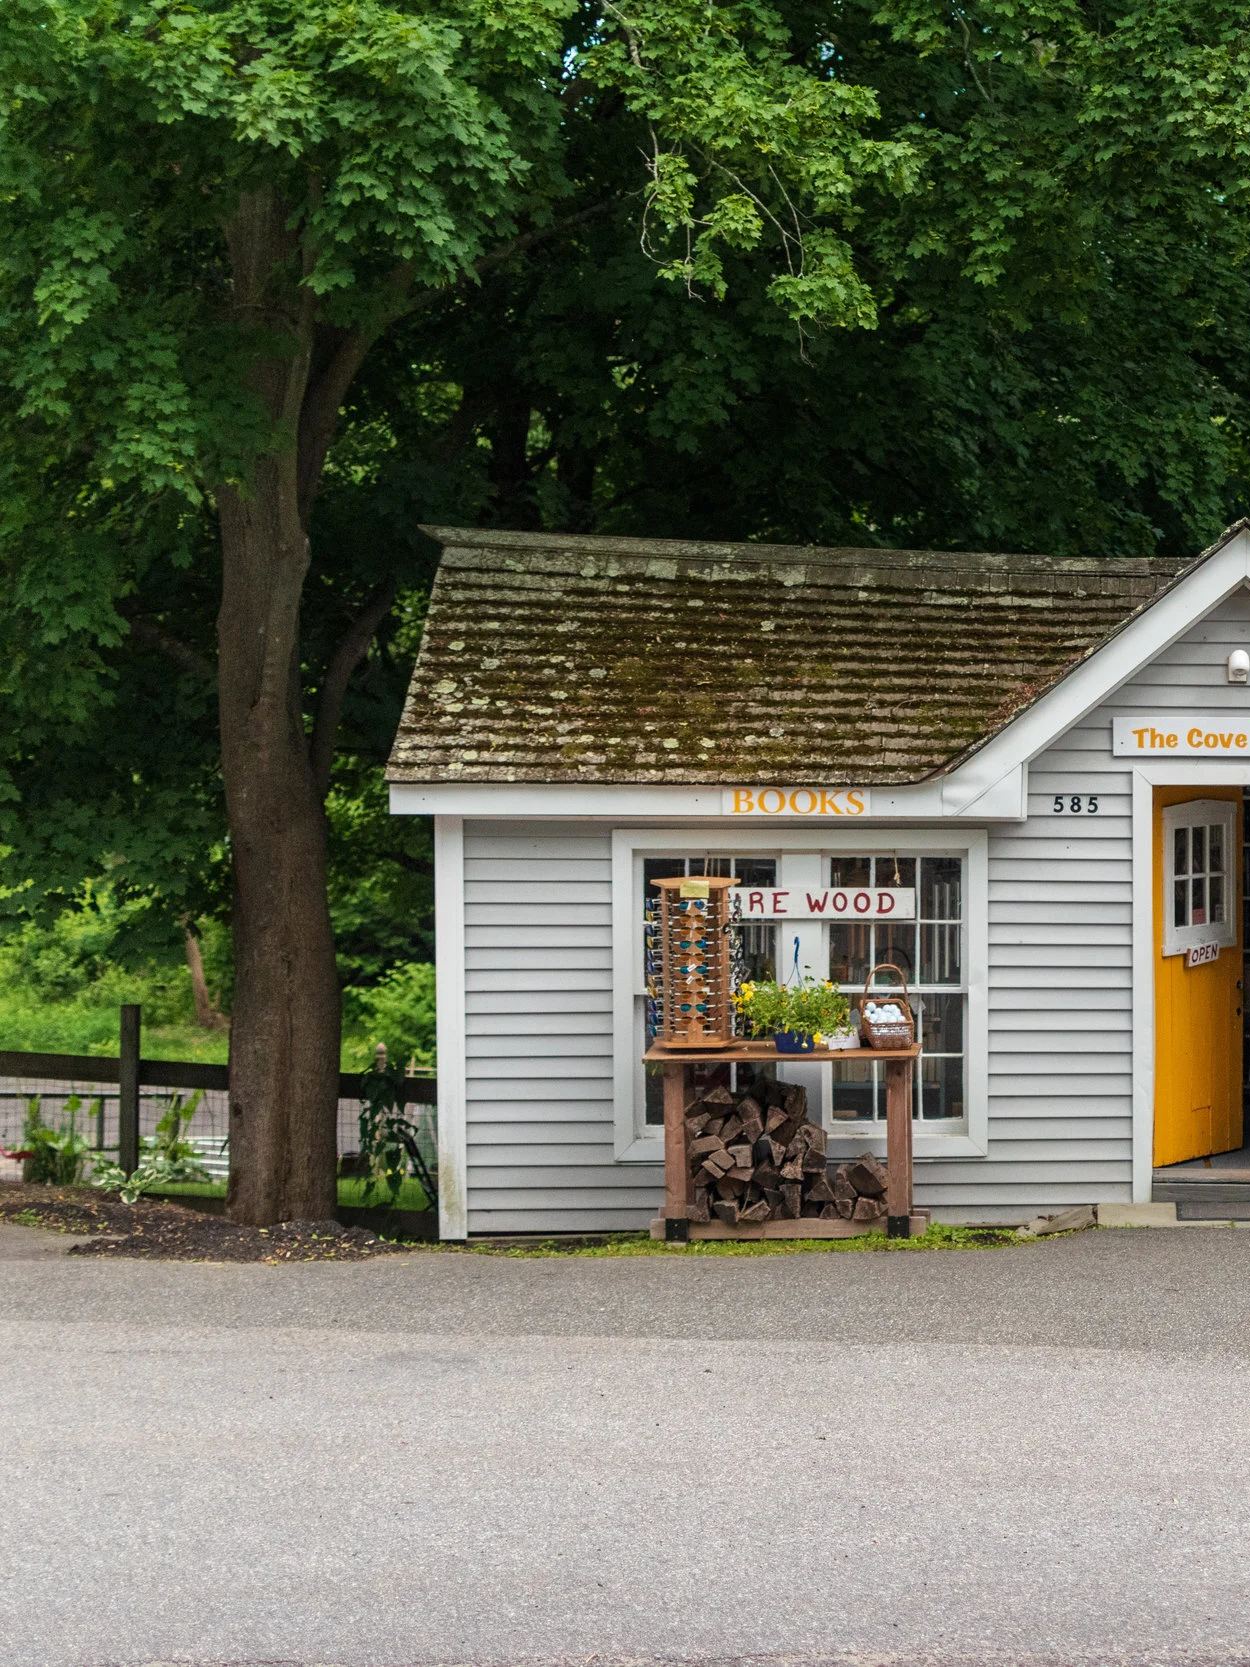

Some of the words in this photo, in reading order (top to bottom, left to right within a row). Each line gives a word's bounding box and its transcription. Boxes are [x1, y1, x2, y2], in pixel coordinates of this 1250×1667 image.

[1132, 728, 1178, 748] The
[1187, 728, 1248, 748] Cove
[731, 788, 865, 815] BOOKS
[1053, 796, 1098, 813] 585
[735, 891, 789, 913] RE
[806, 891, 895, 913] WOOD
[1191, 943, 1218, 963] OPEN
